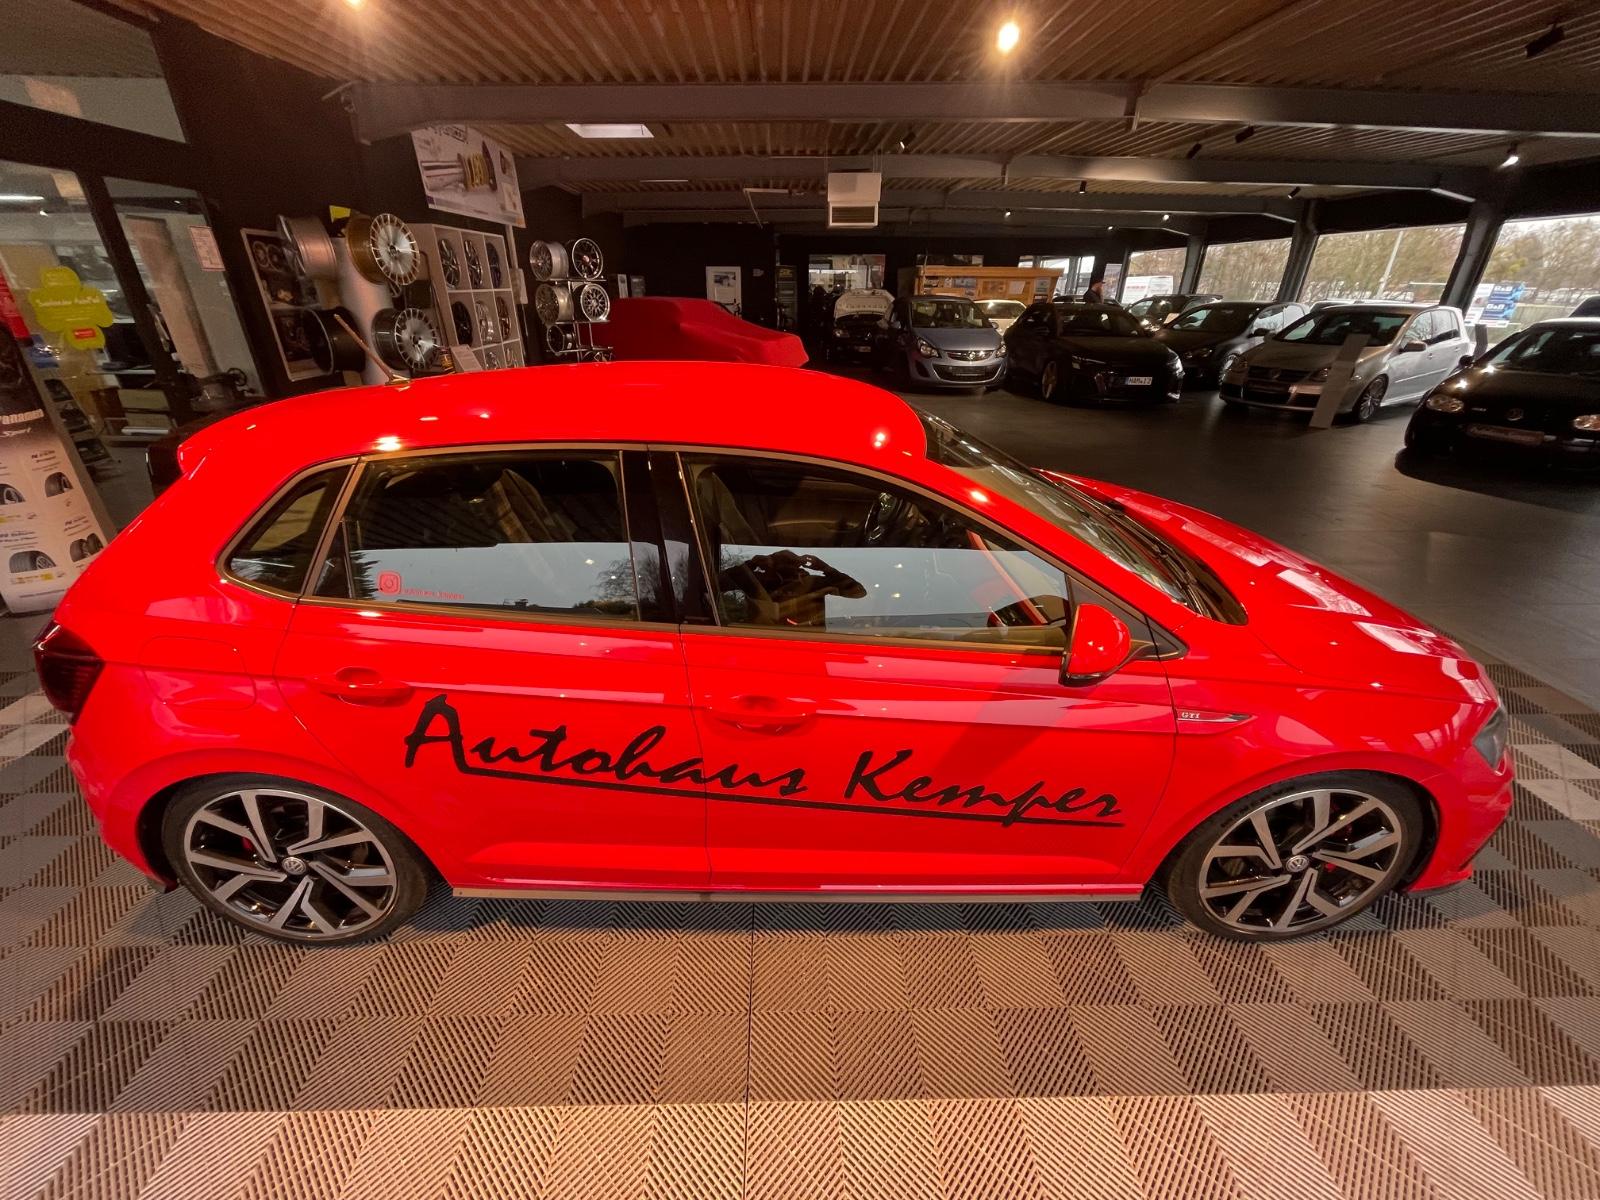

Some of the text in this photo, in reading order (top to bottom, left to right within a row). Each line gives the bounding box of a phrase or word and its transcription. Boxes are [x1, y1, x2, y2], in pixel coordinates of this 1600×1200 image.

[1181, 711, 1201, 719] GTI
[404, 694, 1122, 828] Autohaus Kemper
